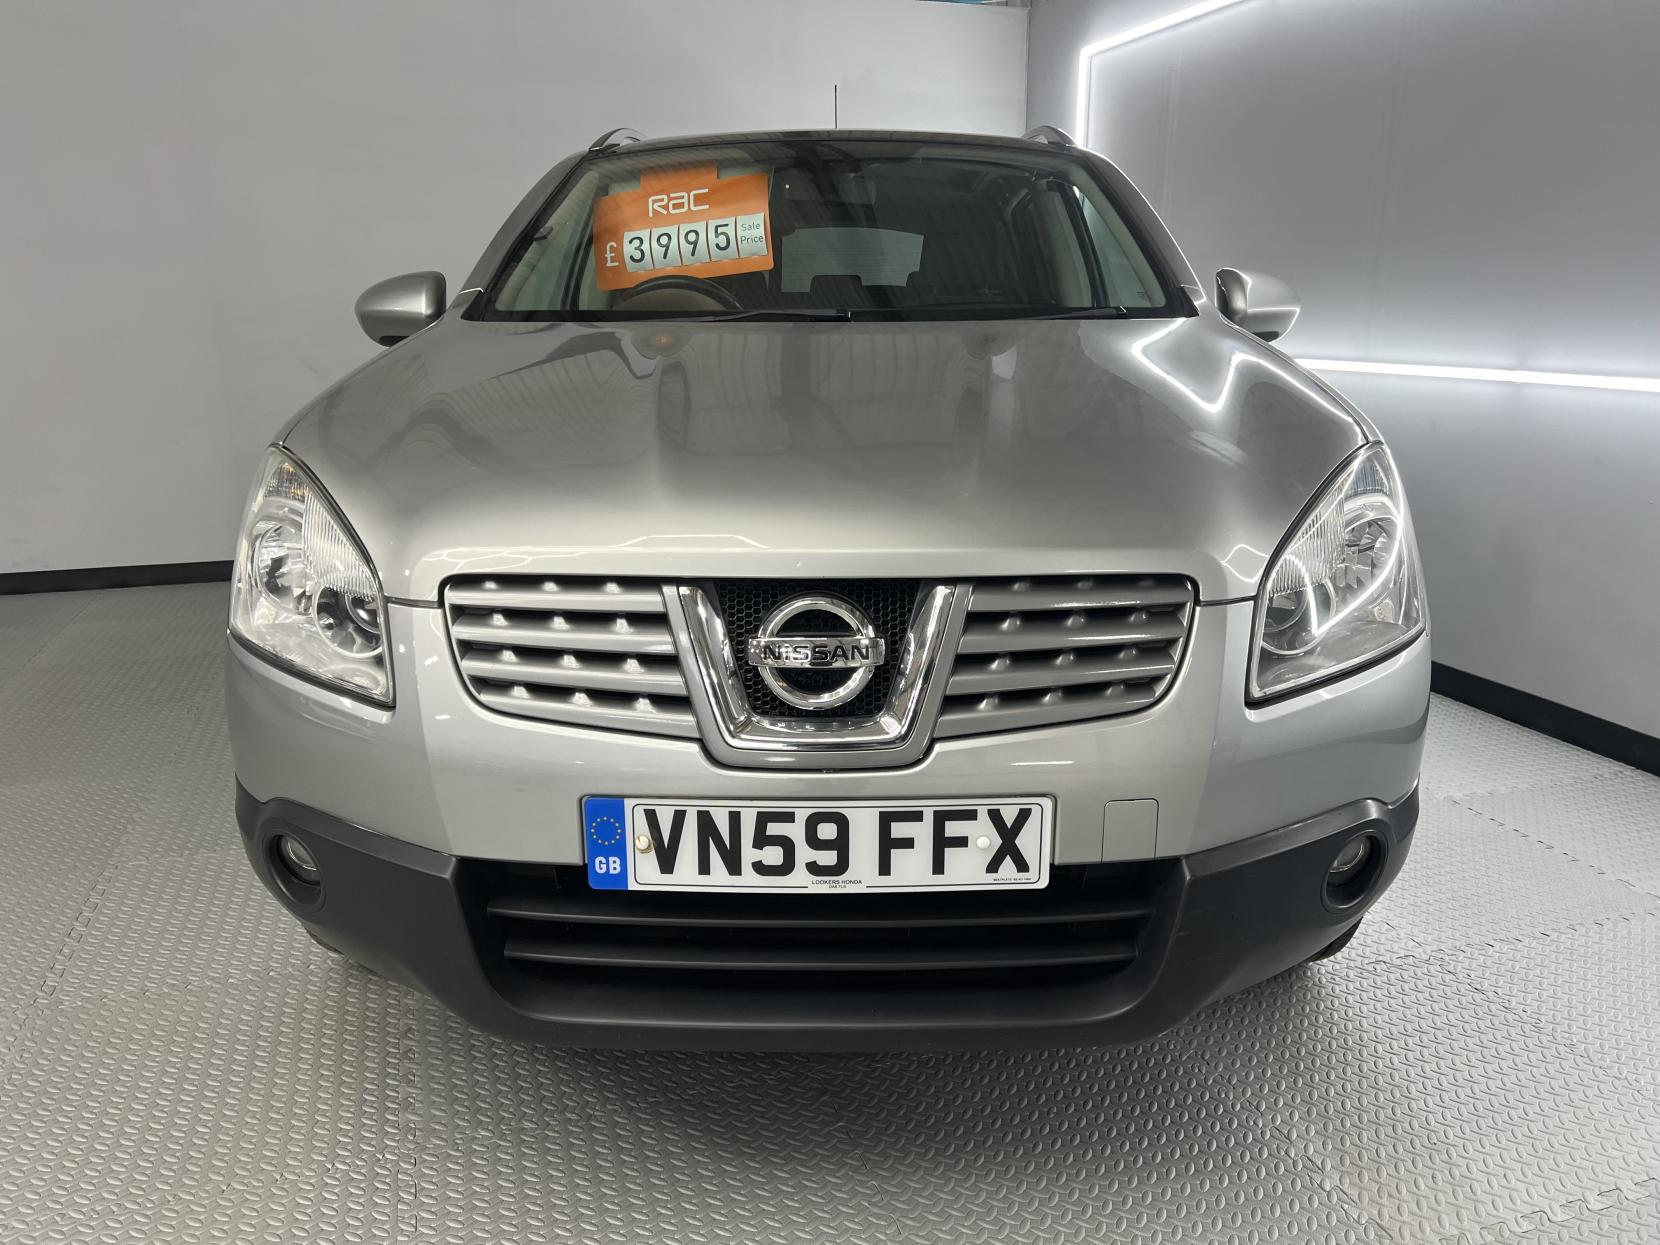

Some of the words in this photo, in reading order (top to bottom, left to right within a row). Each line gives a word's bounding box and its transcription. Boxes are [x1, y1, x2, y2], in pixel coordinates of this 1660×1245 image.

[740, 221, 761, 232] Sale
[740, 234, 764, 245] Price
[762, 644, 870, 662] NISSAN
[643, 809, 850, 877] VN59
[877, 807, 1033, 877] FFX
[594, 856, 621, 875] GB
